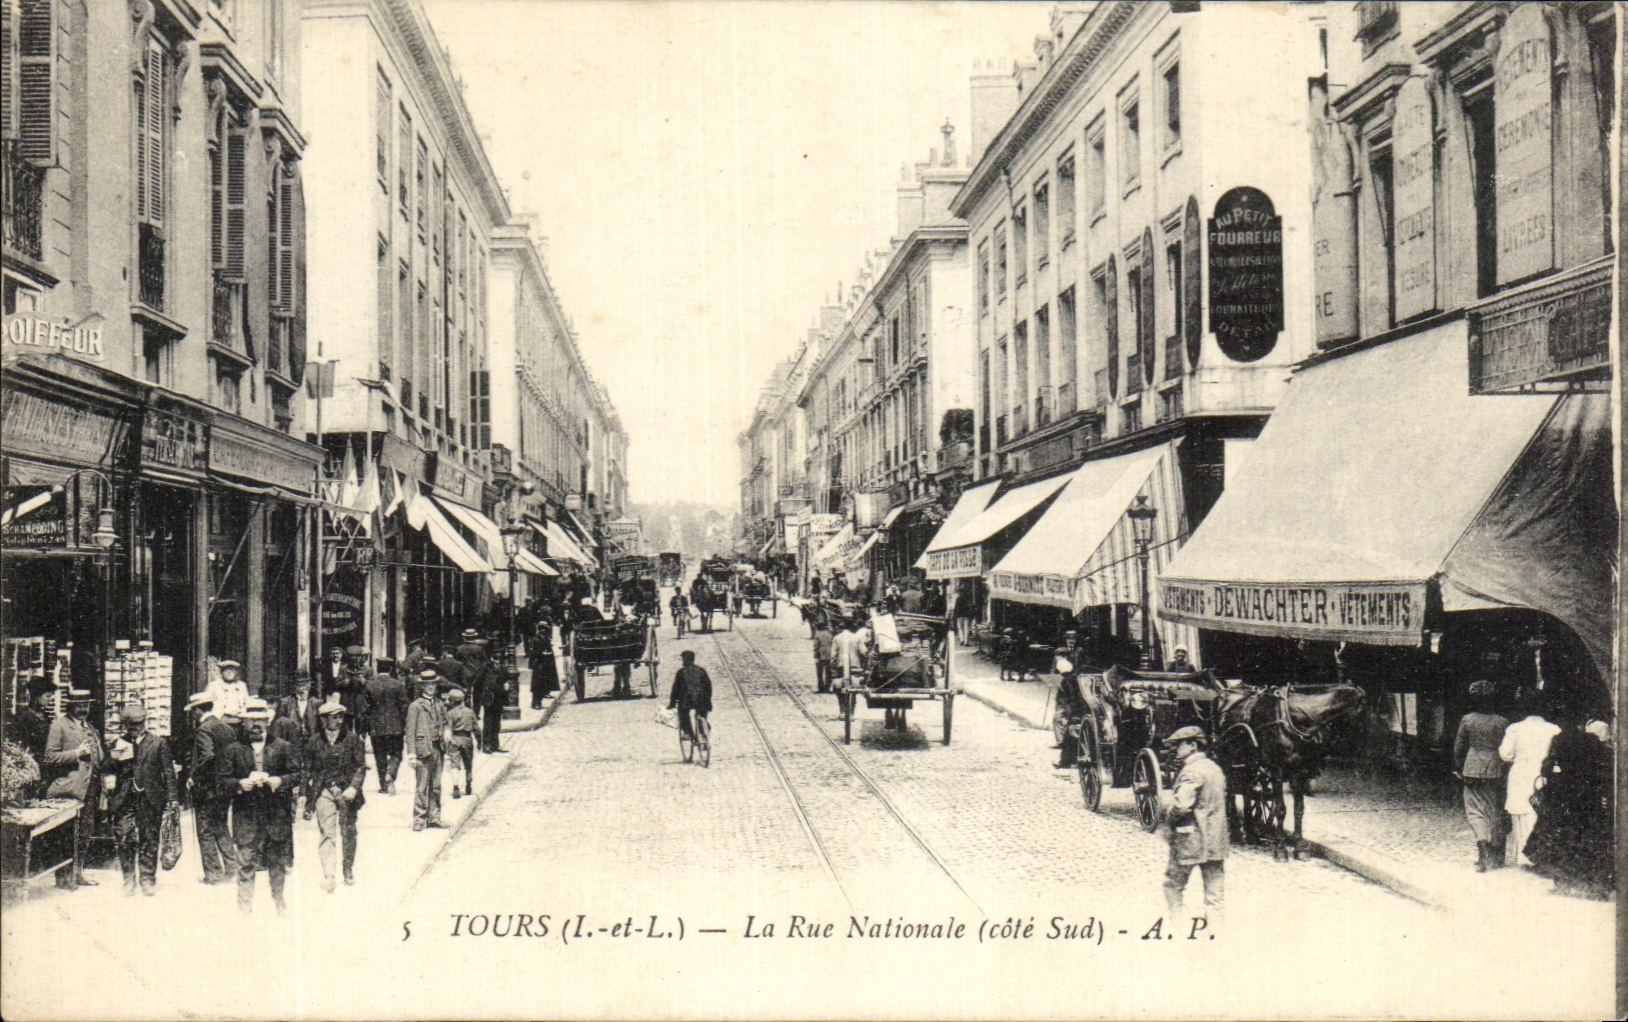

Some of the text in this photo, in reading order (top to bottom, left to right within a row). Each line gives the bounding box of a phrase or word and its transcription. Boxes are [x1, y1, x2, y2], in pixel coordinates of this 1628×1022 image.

[1215, 207, 1273, 230] AU PETIT
[1209, 230, 1281, 246] FOURREUR
[1214, 585, 1330, 626] DEWACHTER
[1338, 586, 1412, 630] VÊTEMENTS
